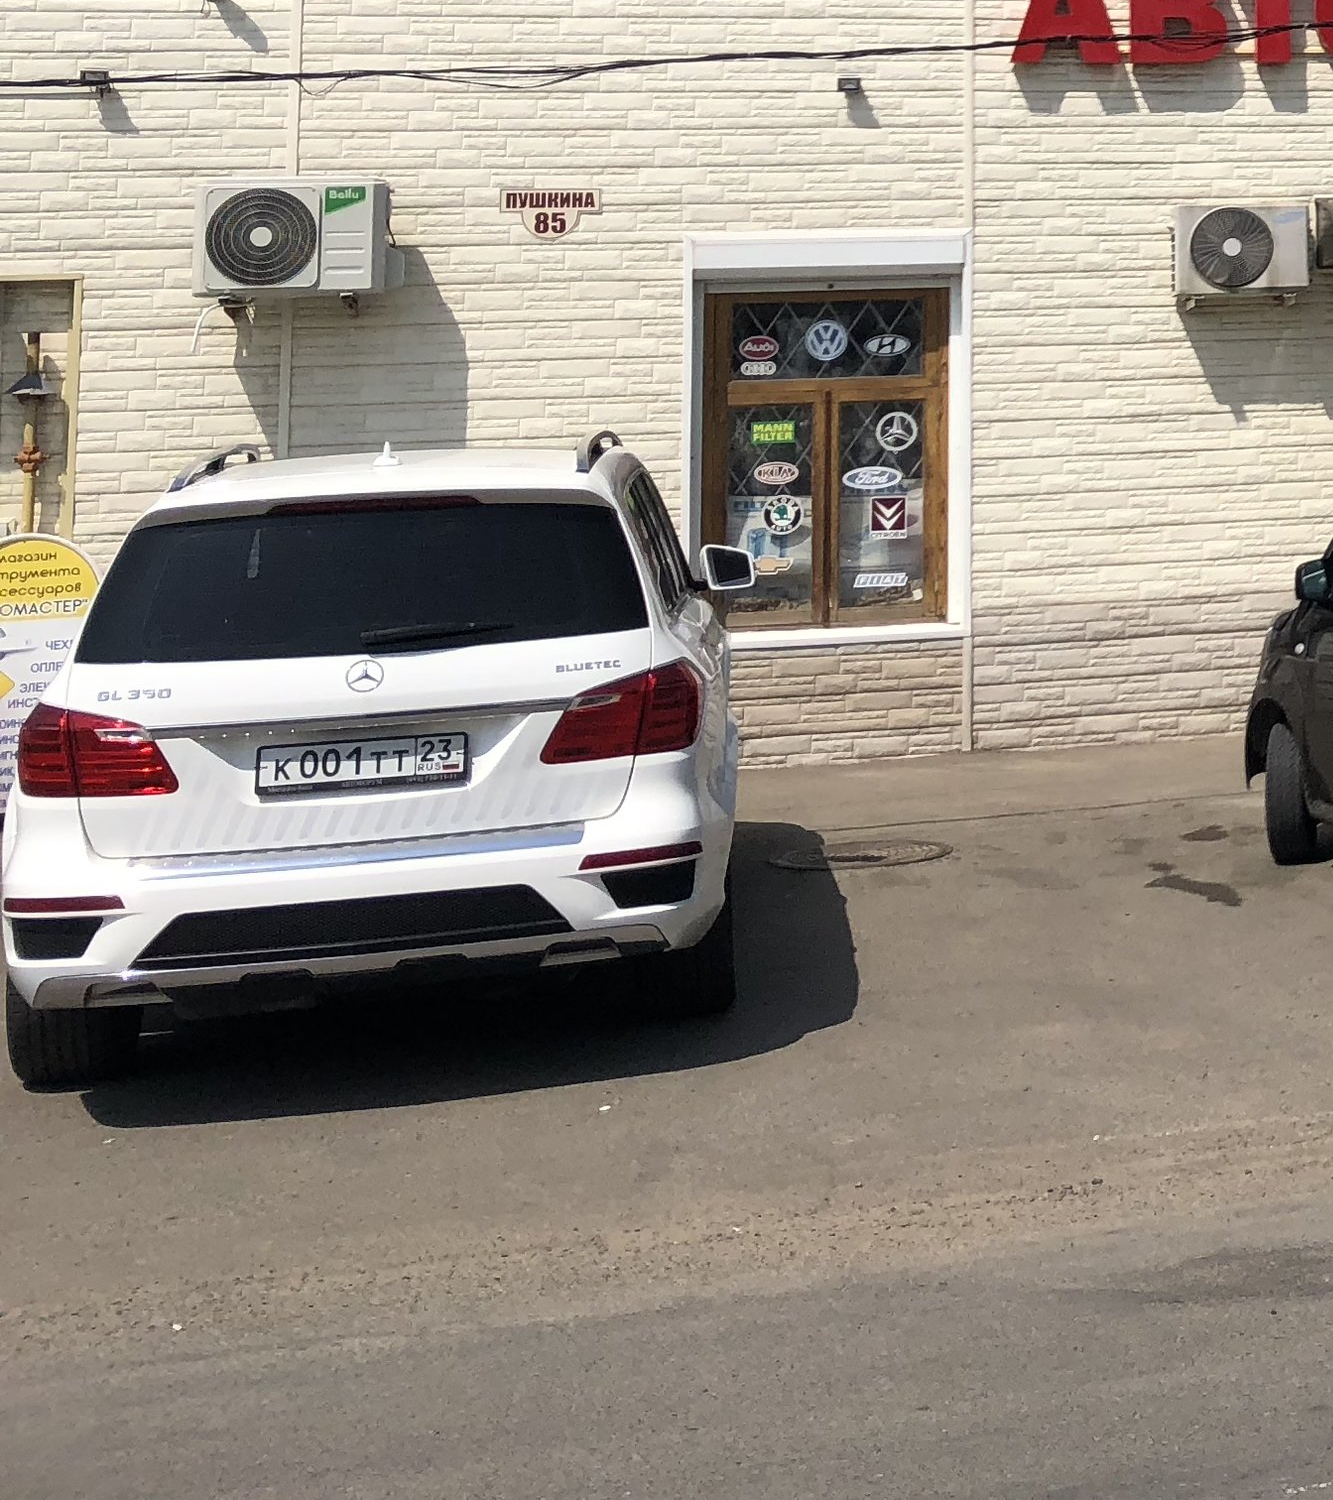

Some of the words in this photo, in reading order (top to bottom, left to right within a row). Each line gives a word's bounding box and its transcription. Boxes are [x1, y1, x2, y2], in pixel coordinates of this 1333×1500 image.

[506, 192, 595, 208] ПУШКИНА
[534, 212, 566, 233] 85
[753, 423, 793, 432] MANN
[753, 432, 793, 441] FILTER
[760, 466, 791, 479] KIA
[855, 470, 890, 484] Ford
[857, 574, 906, 586] FIAT
[556, 660, 621, 673] BLUETEC
[97, 690, 122, 702] GL
[128, 688, 171, 700] 350
[8, 698, 39, 708] ИНС
[275, 746, 409, 781] К001ТТ
[420, 739, 452, 762] 23
[418, 762, 441, 771] RUS
